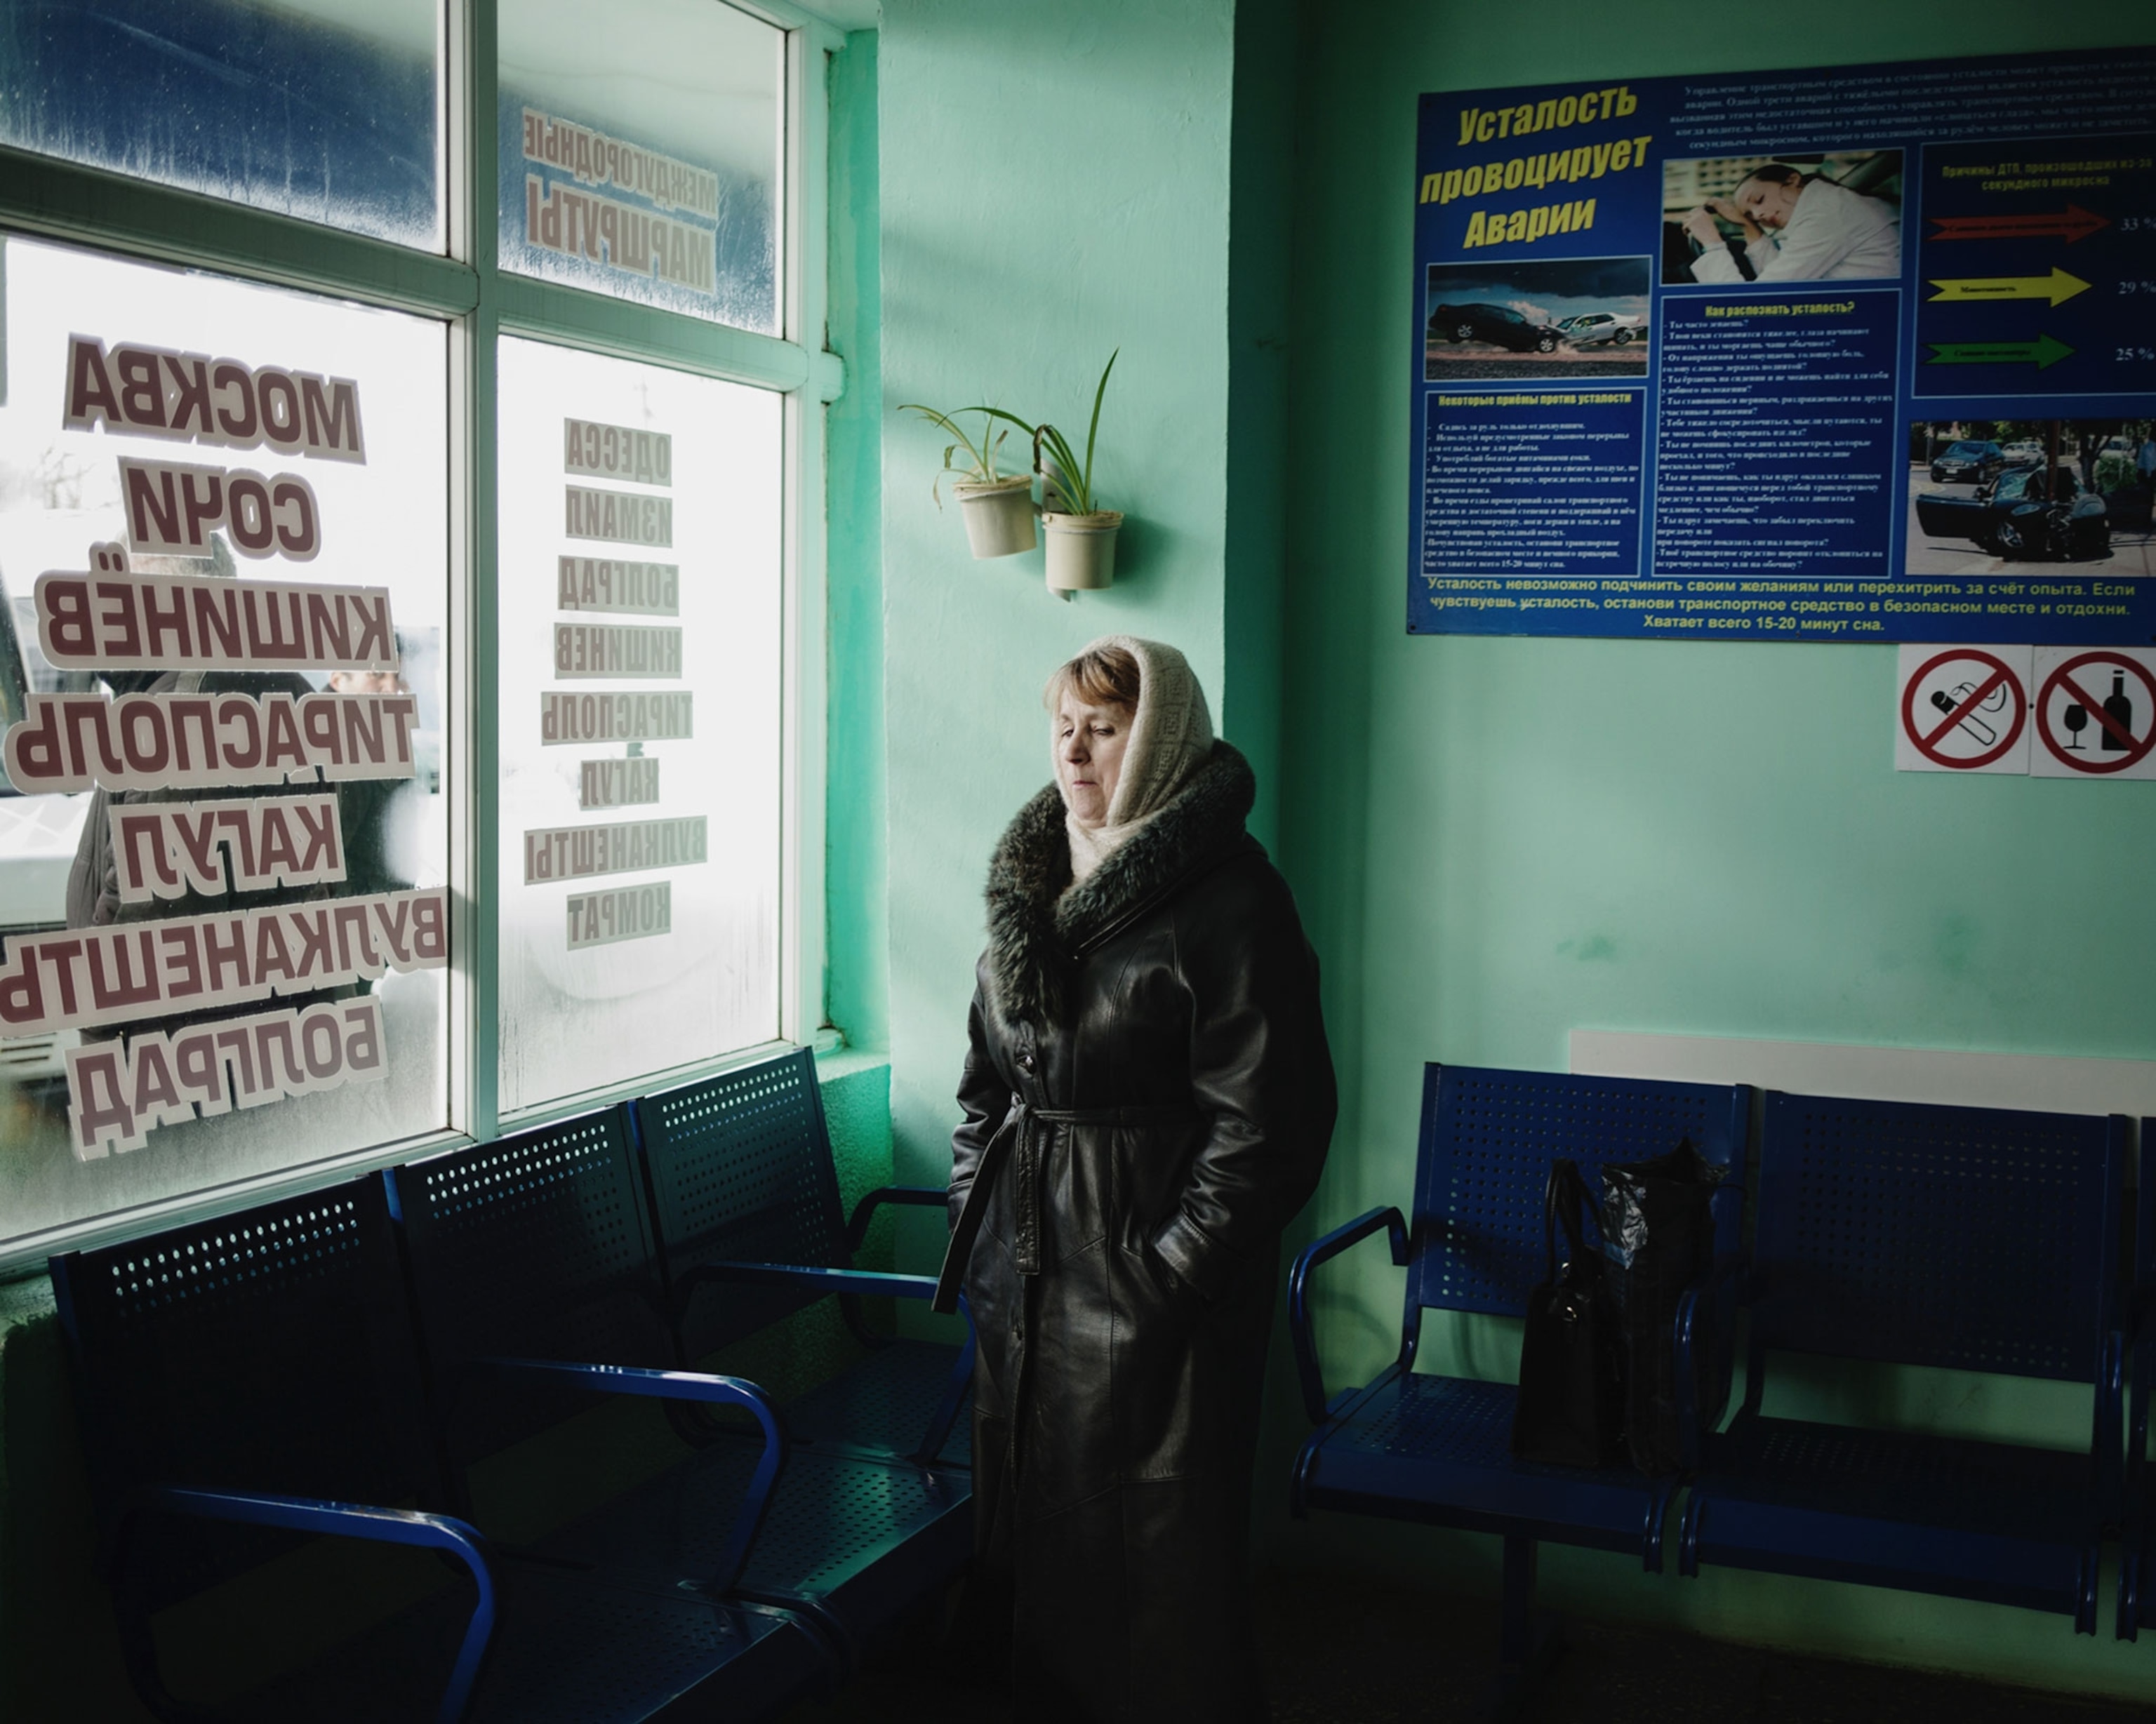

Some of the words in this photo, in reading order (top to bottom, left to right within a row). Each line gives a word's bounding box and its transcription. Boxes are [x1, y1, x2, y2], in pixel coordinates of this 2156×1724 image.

[1458, 87, 1637, 145] Усталость
[1420, 135, 1652, 204] провоцирует
[1942, 166, 1995, 178] Причины
[2025, 160, 2117, 175] произошедших
[1981, 178, 2049, 192] секундного
[2051, 176, 2110, 188] микросна
[1463, 199, 1596, 250] Аварии
[2121, 218, 2138, 231] 33
[2119, 281, 2136, 294] 29
[1705, 305, 1726, 317] Как
[1726, 303, 1790, 318] распознать
[1792, 301, 1856, 316] усталость?
[2116, 347, 2134, 361] 25
[2138, 347, 2155, 360] %
[1438, 394, 1496, 406] Некоторые
[1496, 394, 1539, 406] приёмы
[1540, 394, 1576, 406] против
[1577, 393, 1632, 406] усталости
[1430, 577, 1501, 589] Усталость
[1506, 580, 1597, 590] невозможно
[1602, 581, 1685, 592] подчинить
[1687, 582, 1735, 591] своим
[1741, 582, 1818, 592] желаниям
[1824, 583, 1856, 592] или
[1856, 583, 1964, 596] перехитрить
[1967, 584, 1983, 593] за
[1989, 581, 2028, 593] счёт
[2093, 582, 2134, 594] Если
[1430, 599, 1517, 610] чувствуешь
[1602, 599, 1673, 609] останови
[1676, 600, 1788, 613] транспортное
[1788, 601, 1864, 613] средство
[1870, 601, 1882, 610] в
[1884, 599, 1985, 611] безопасном
[1988, 603, 2038, 612] месте
[2041, 603, 2051, 612] и
[1644, 615, 1706, 627] Хватает
[1708, 618, 1750, 628] всего
[1756, 616, 1796, 628] 15-20
[1801, 620, 1850, 632] минут
